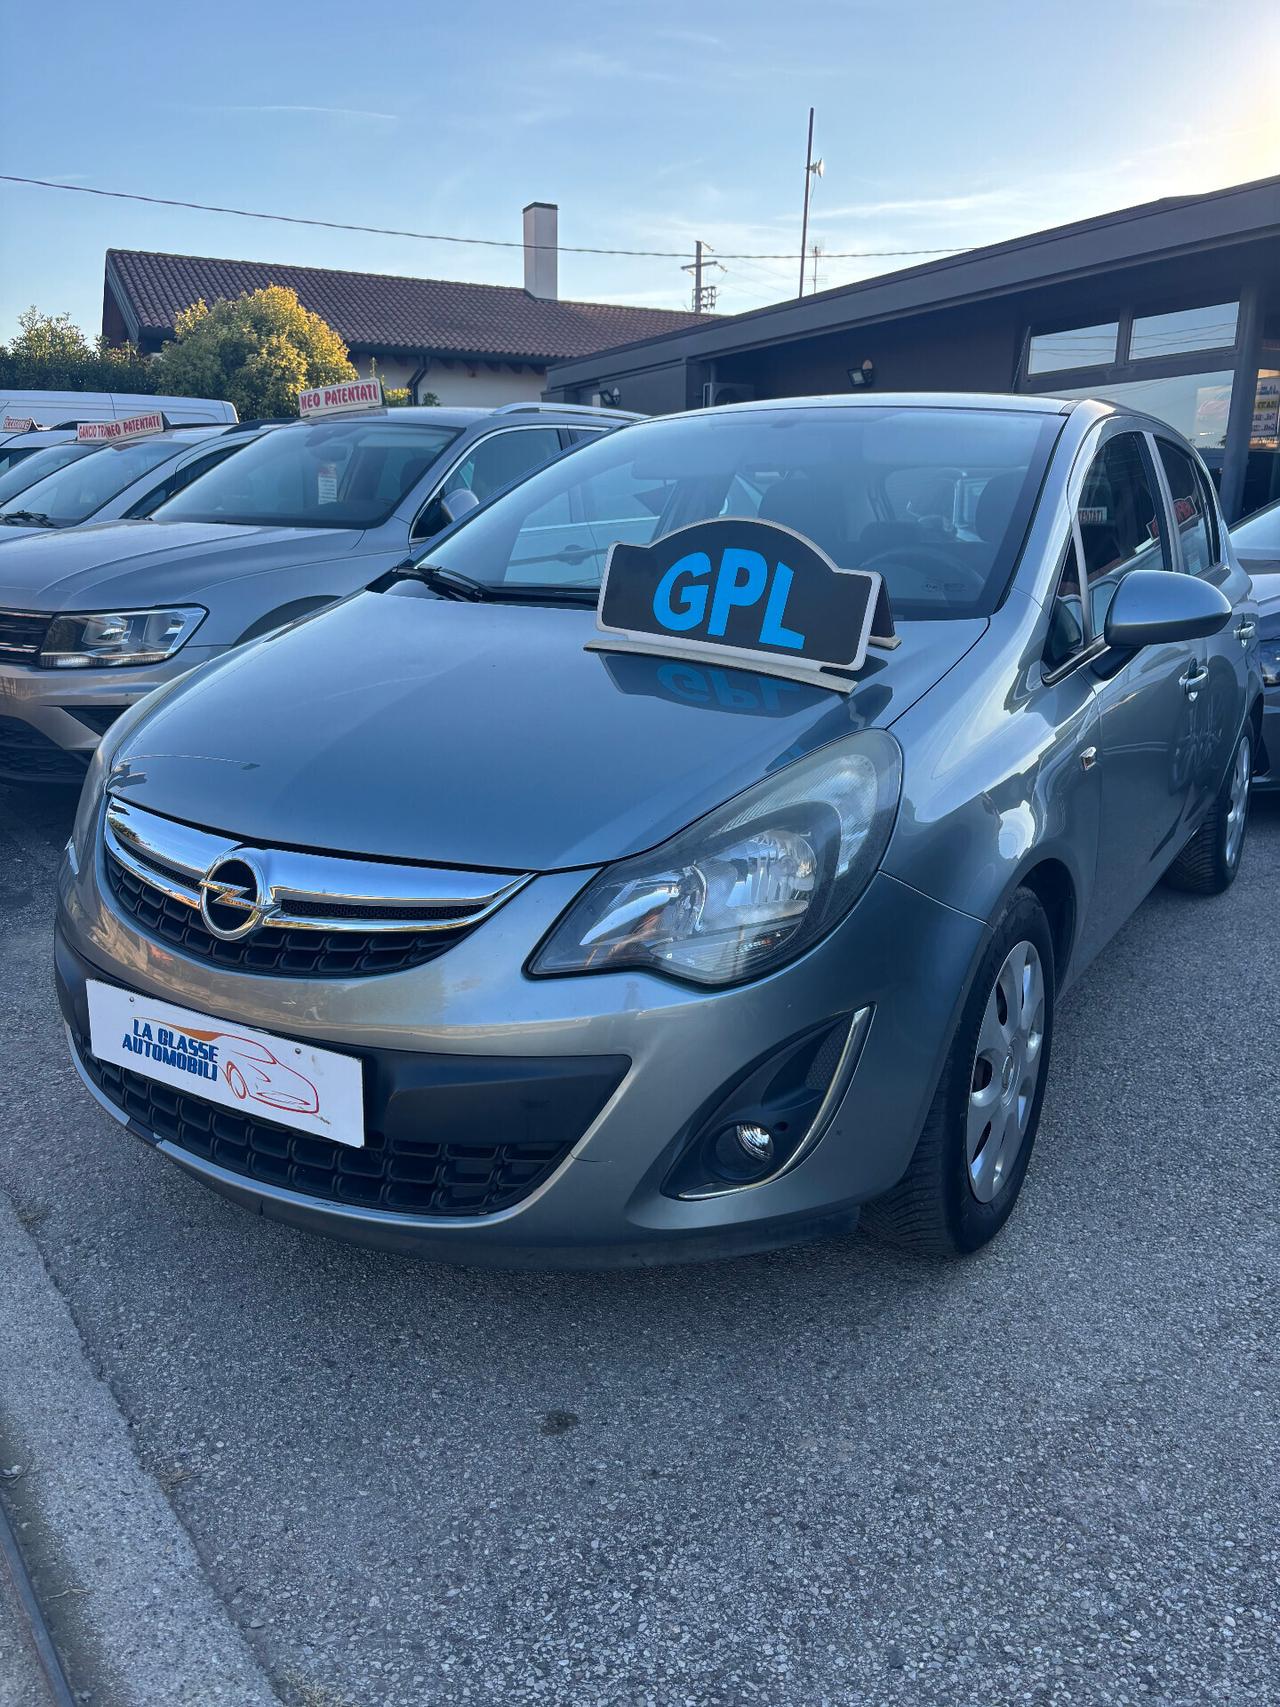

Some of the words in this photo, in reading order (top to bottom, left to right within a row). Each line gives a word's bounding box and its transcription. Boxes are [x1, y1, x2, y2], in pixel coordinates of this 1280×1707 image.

[300, 393, 321, 410] NEO
[324, 384, 378, 406] PATENTATI
[106, 423, 122, 438] NEO
[123, 415, 160, 433] PATENTATI
[653, 548, 806, 650] GPL
[122, 1034, 218, 1081] AUTOMOBILI
[133, 1019, 153, 1041] LA
[158, 1028, 219, 1063] CLASSE
